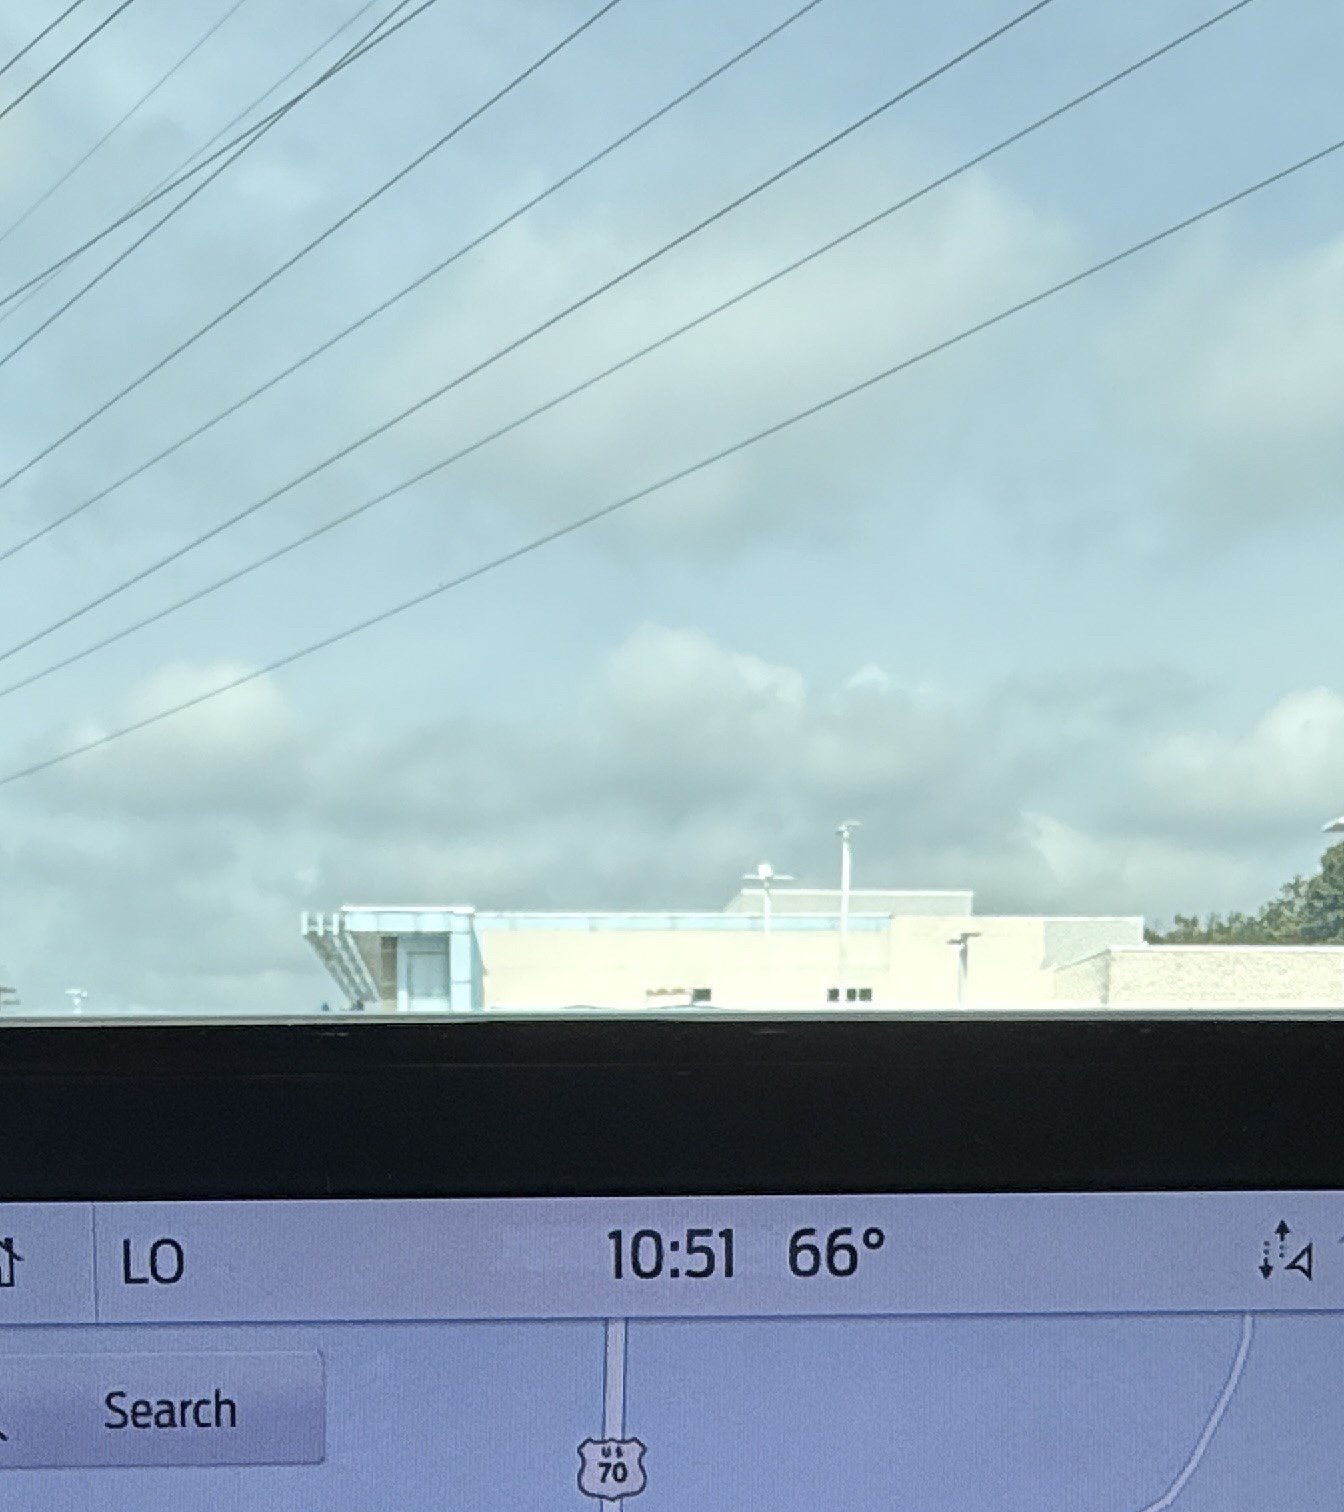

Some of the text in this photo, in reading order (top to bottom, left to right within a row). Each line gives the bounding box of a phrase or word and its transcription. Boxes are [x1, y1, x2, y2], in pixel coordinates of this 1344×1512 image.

[122, 1238, 185, 1285] LO
[607, 1228, 734, 1280] 10:51
[788, 1226, 886, 1278] 66°
[104, 1388, 237, 1430] Search
[597, 1461, 628, 1483] 70
